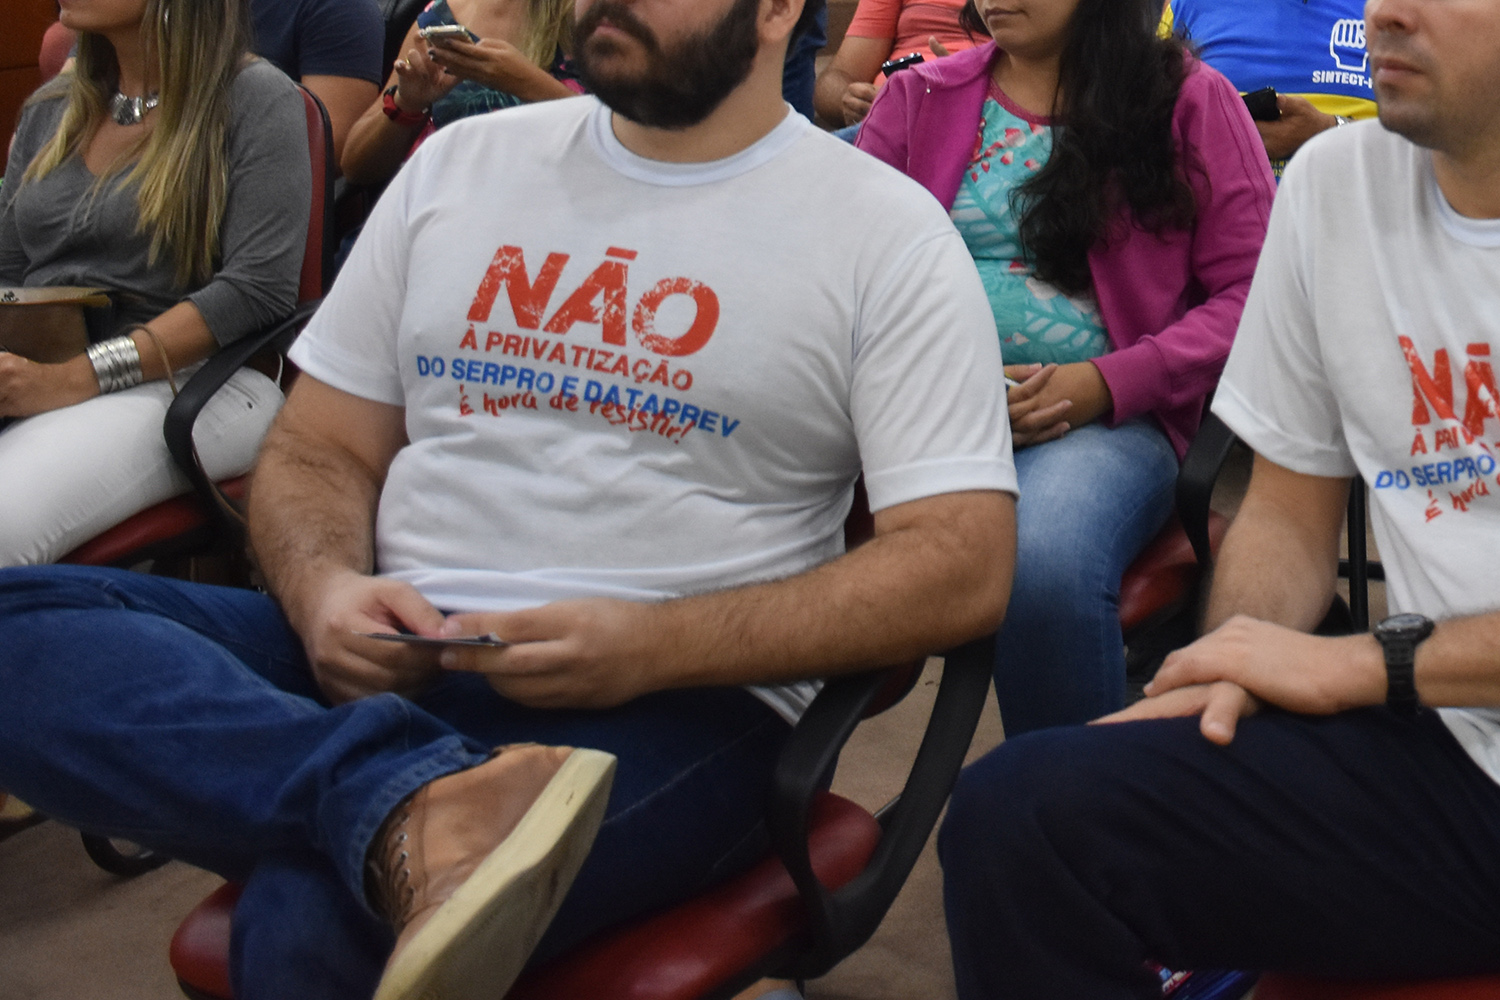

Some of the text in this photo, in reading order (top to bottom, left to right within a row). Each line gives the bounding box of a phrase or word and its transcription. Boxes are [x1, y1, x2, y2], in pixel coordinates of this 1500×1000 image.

[466, 245, 720, 357] NÃO
[459, 324, 693, 391] À PRIVATIZAÇÃO
[416, 355, 740, 438] DO SERPRO E DATAPREV
[484, 390, 538, 417] hora
[550, 389, 578, 412] de
[590, 396, 697, 444] resistir!
[1410, 427, 1428, 456] À
[1375, 469, 1411, 490] DO
[1411, 454, 1496, 487] SERPRO
[1449, 477, 1491, 512] hora
